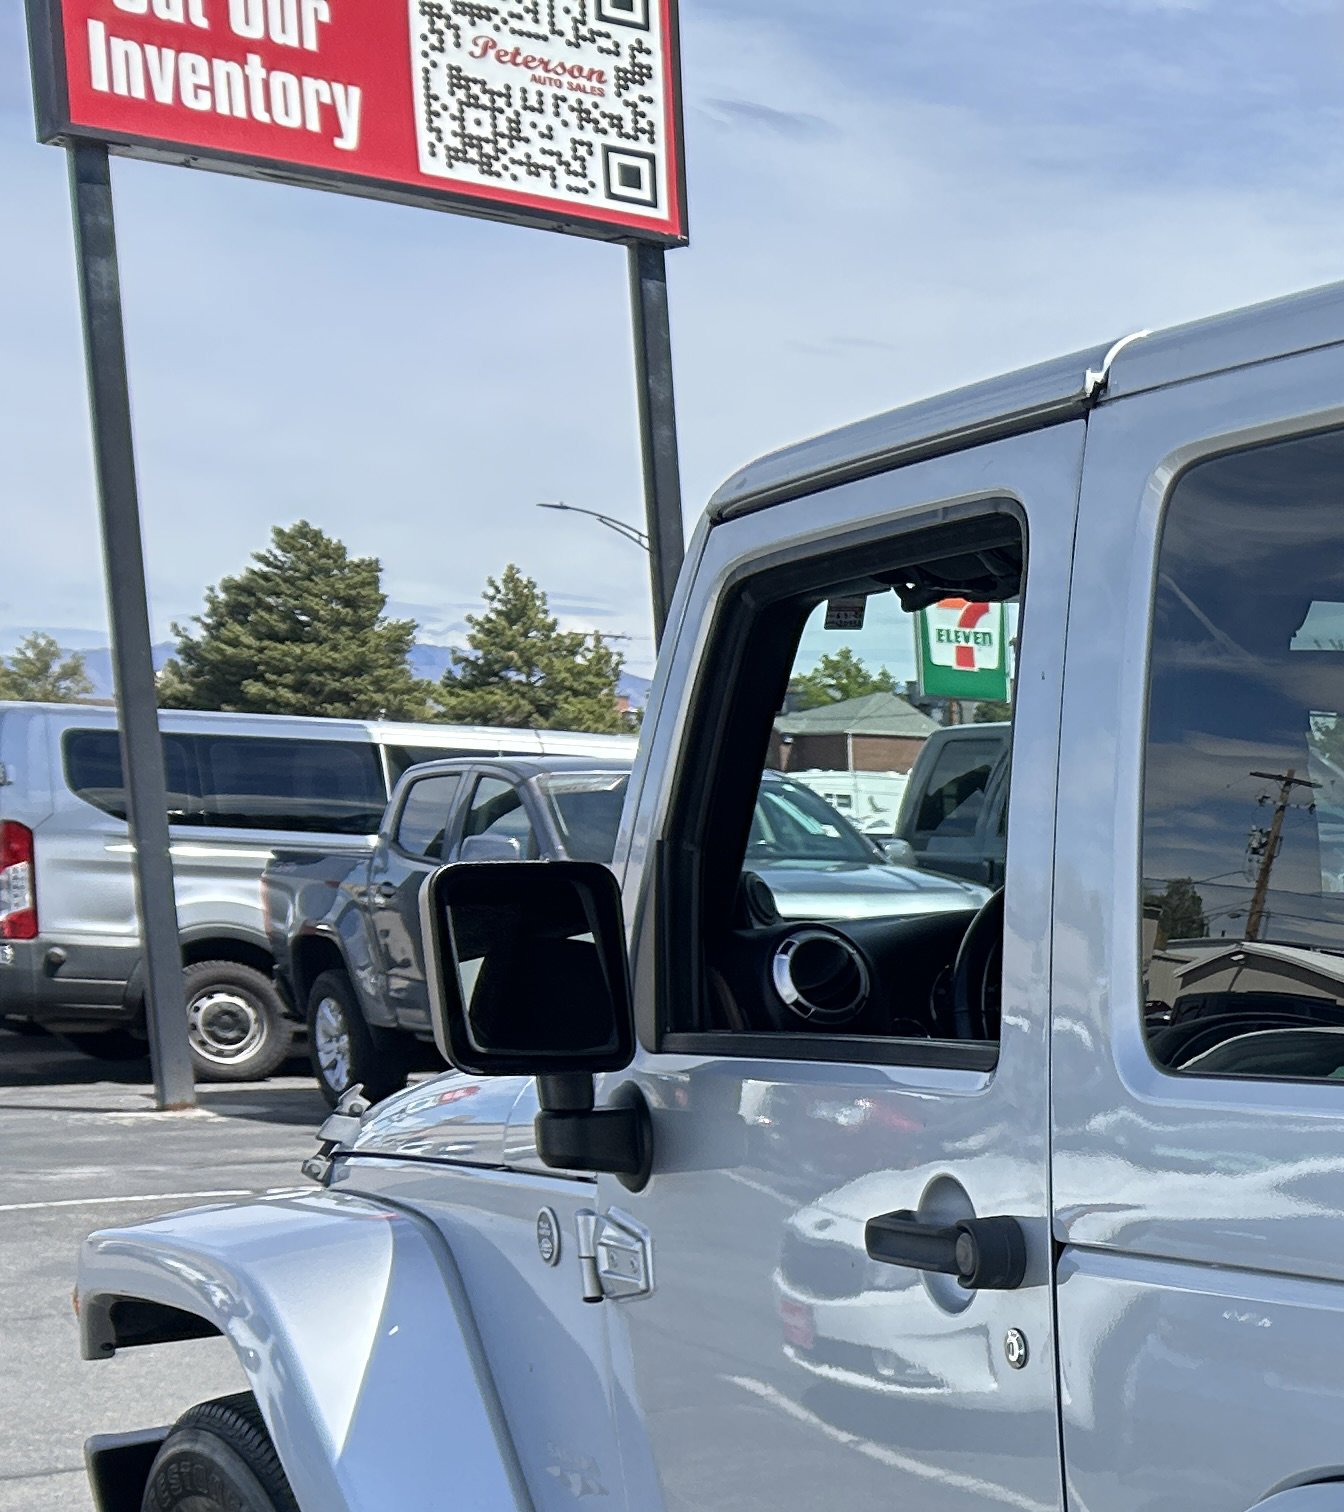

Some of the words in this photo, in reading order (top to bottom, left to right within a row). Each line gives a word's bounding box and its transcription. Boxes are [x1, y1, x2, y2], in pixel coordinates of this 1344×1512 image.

[468, 35, 608, 84] Peterson
[87, 18, 362, 151] Inventory
[530, 73, 563, 89] AUTO
[567, 80, 606, 98] SALES
